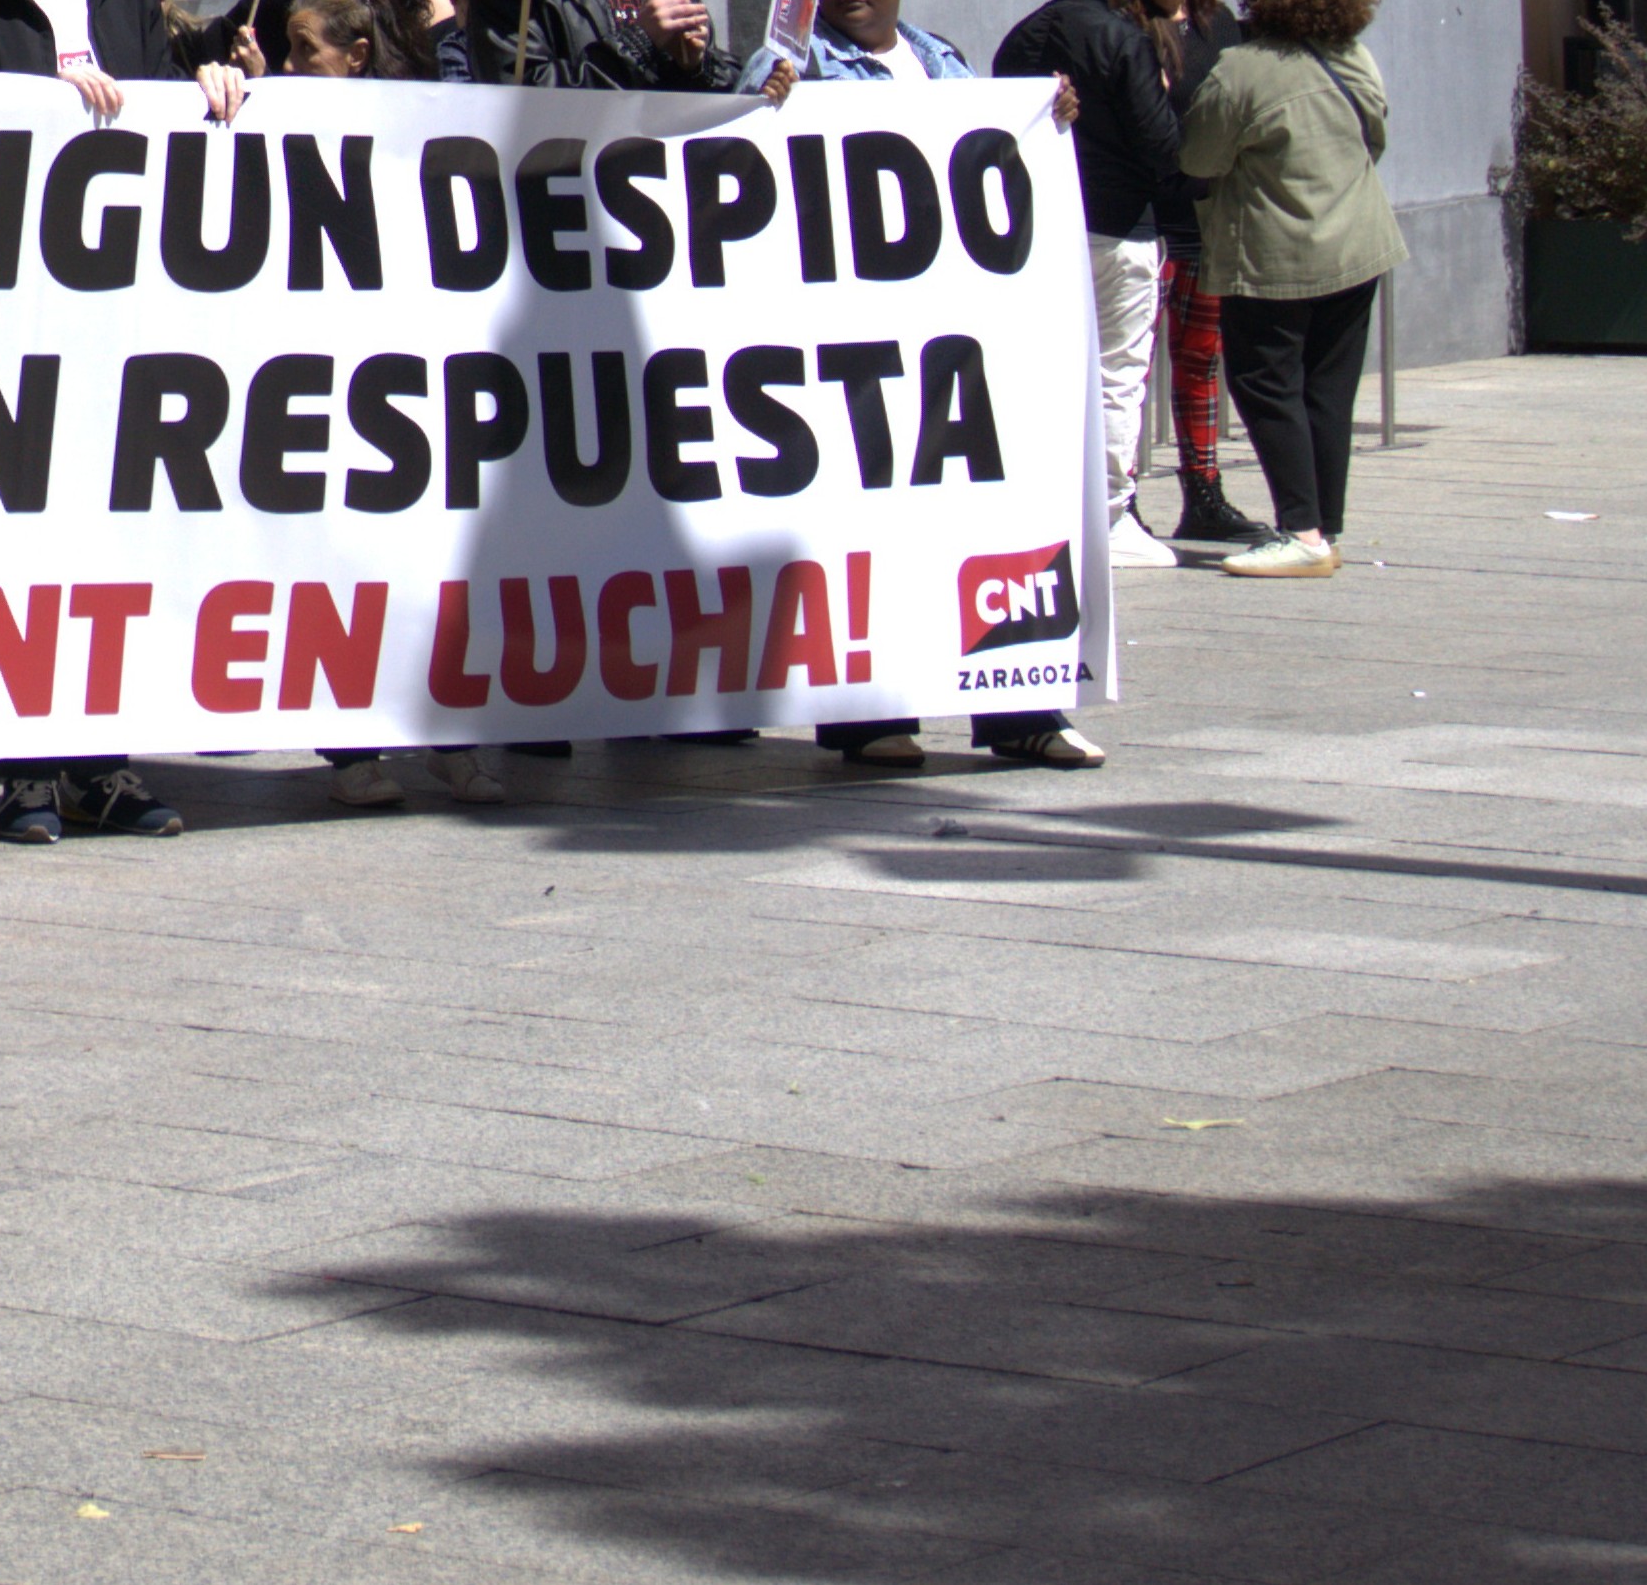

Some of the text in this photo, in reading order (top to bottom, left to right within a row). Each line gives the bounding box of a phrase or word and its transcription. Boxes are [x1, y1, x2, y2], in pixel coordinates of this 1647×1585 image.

[421, 128, 1033, 292] DESPIDO
[109, 334, 1004, 514] RESPUESTA
[190, 579, 389, 714] EN
[428, 550, 872, 708] LUCHA!
[958, 661, 1095, 692] ZARAGOZA
[974, 570, 1058, 624] CNT
